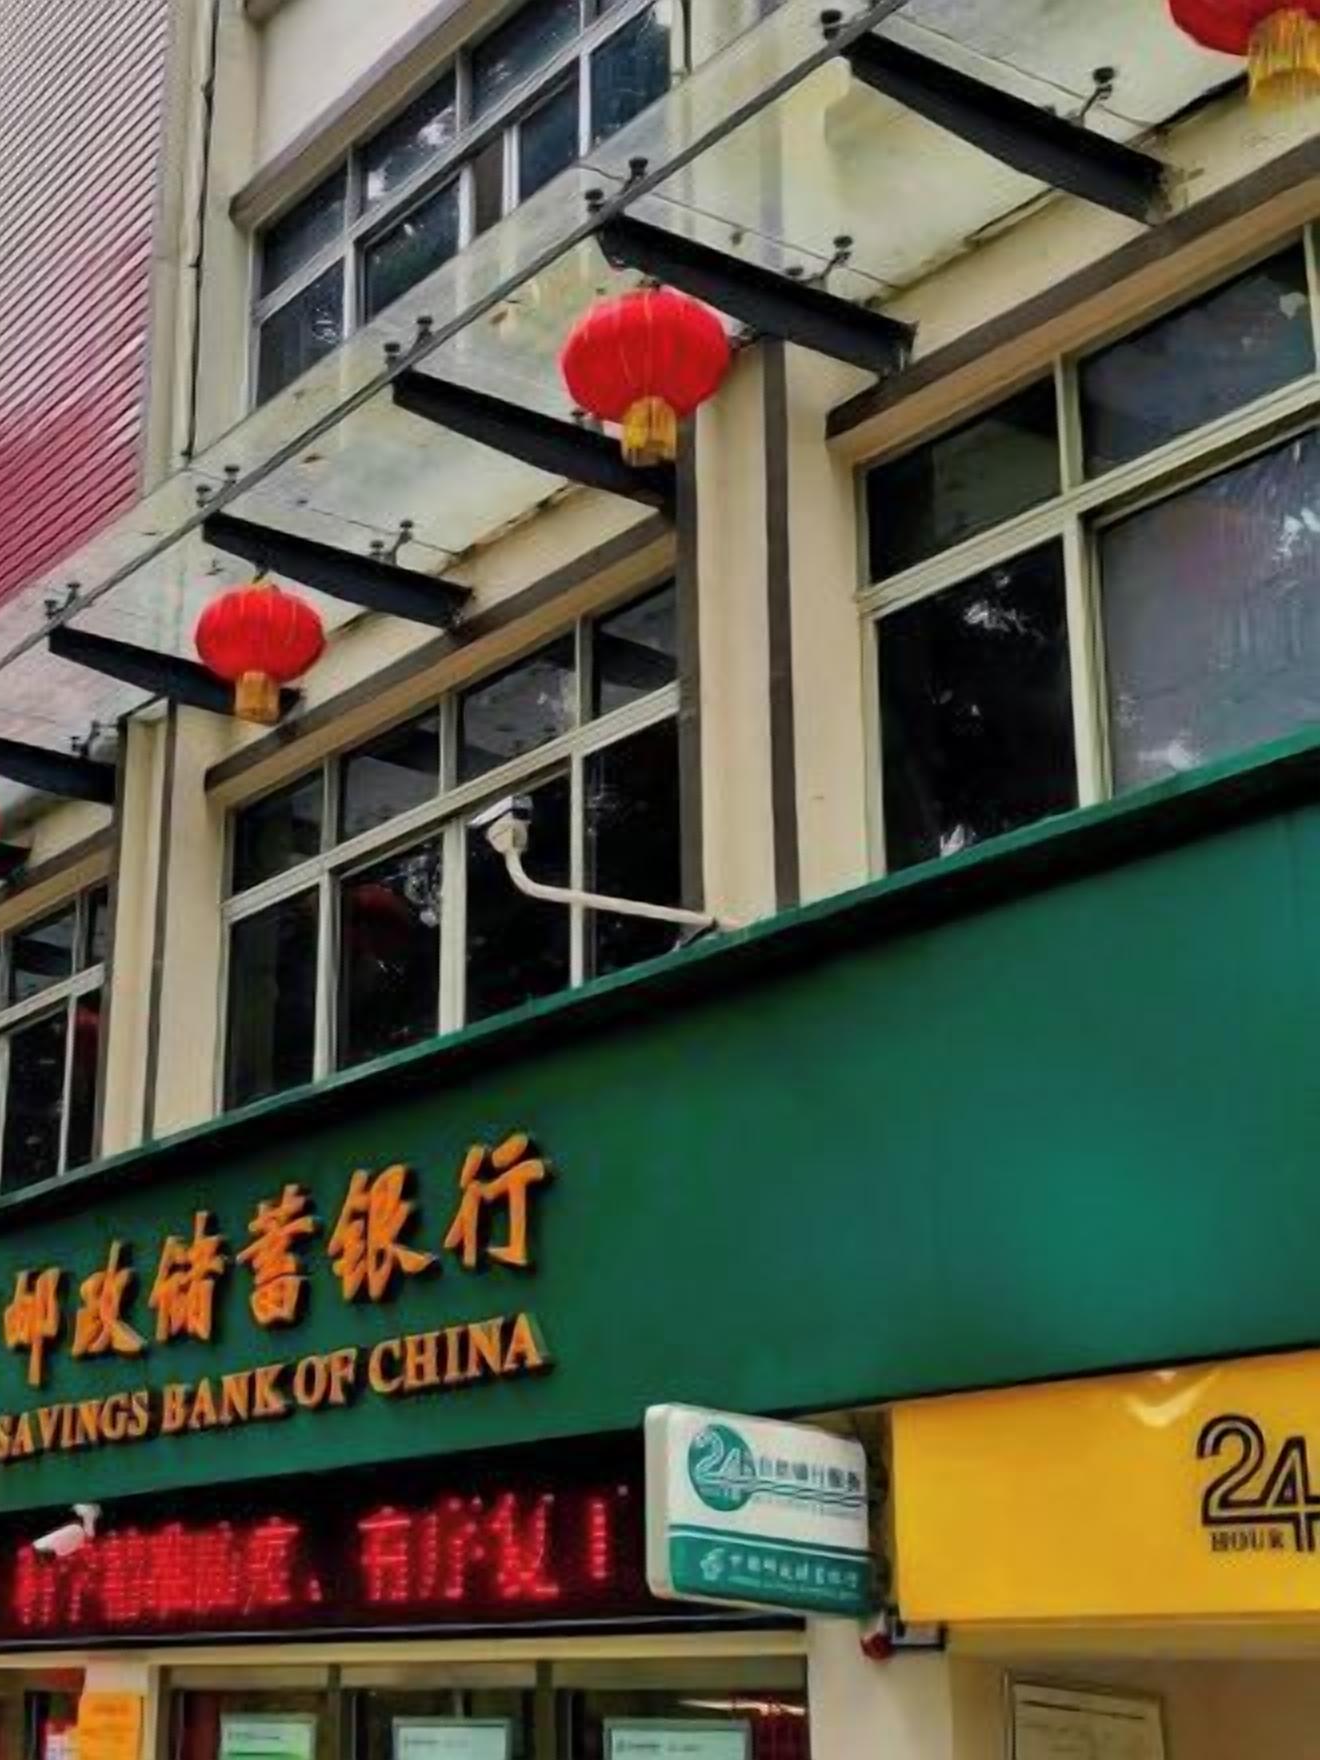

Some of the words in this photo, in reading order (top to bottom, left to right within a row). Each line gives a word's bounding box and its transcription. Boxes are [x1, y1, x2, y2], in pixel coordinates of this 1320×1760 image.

[161, 1363, 287, 1433] BANK
[294, 1348, 357, 1406] OF
[368, 1312, 548, 1392] CHINA
[1197, 1414, 1320, 1552] 24
[1210, 1529, 1284, 1552] HOUR
